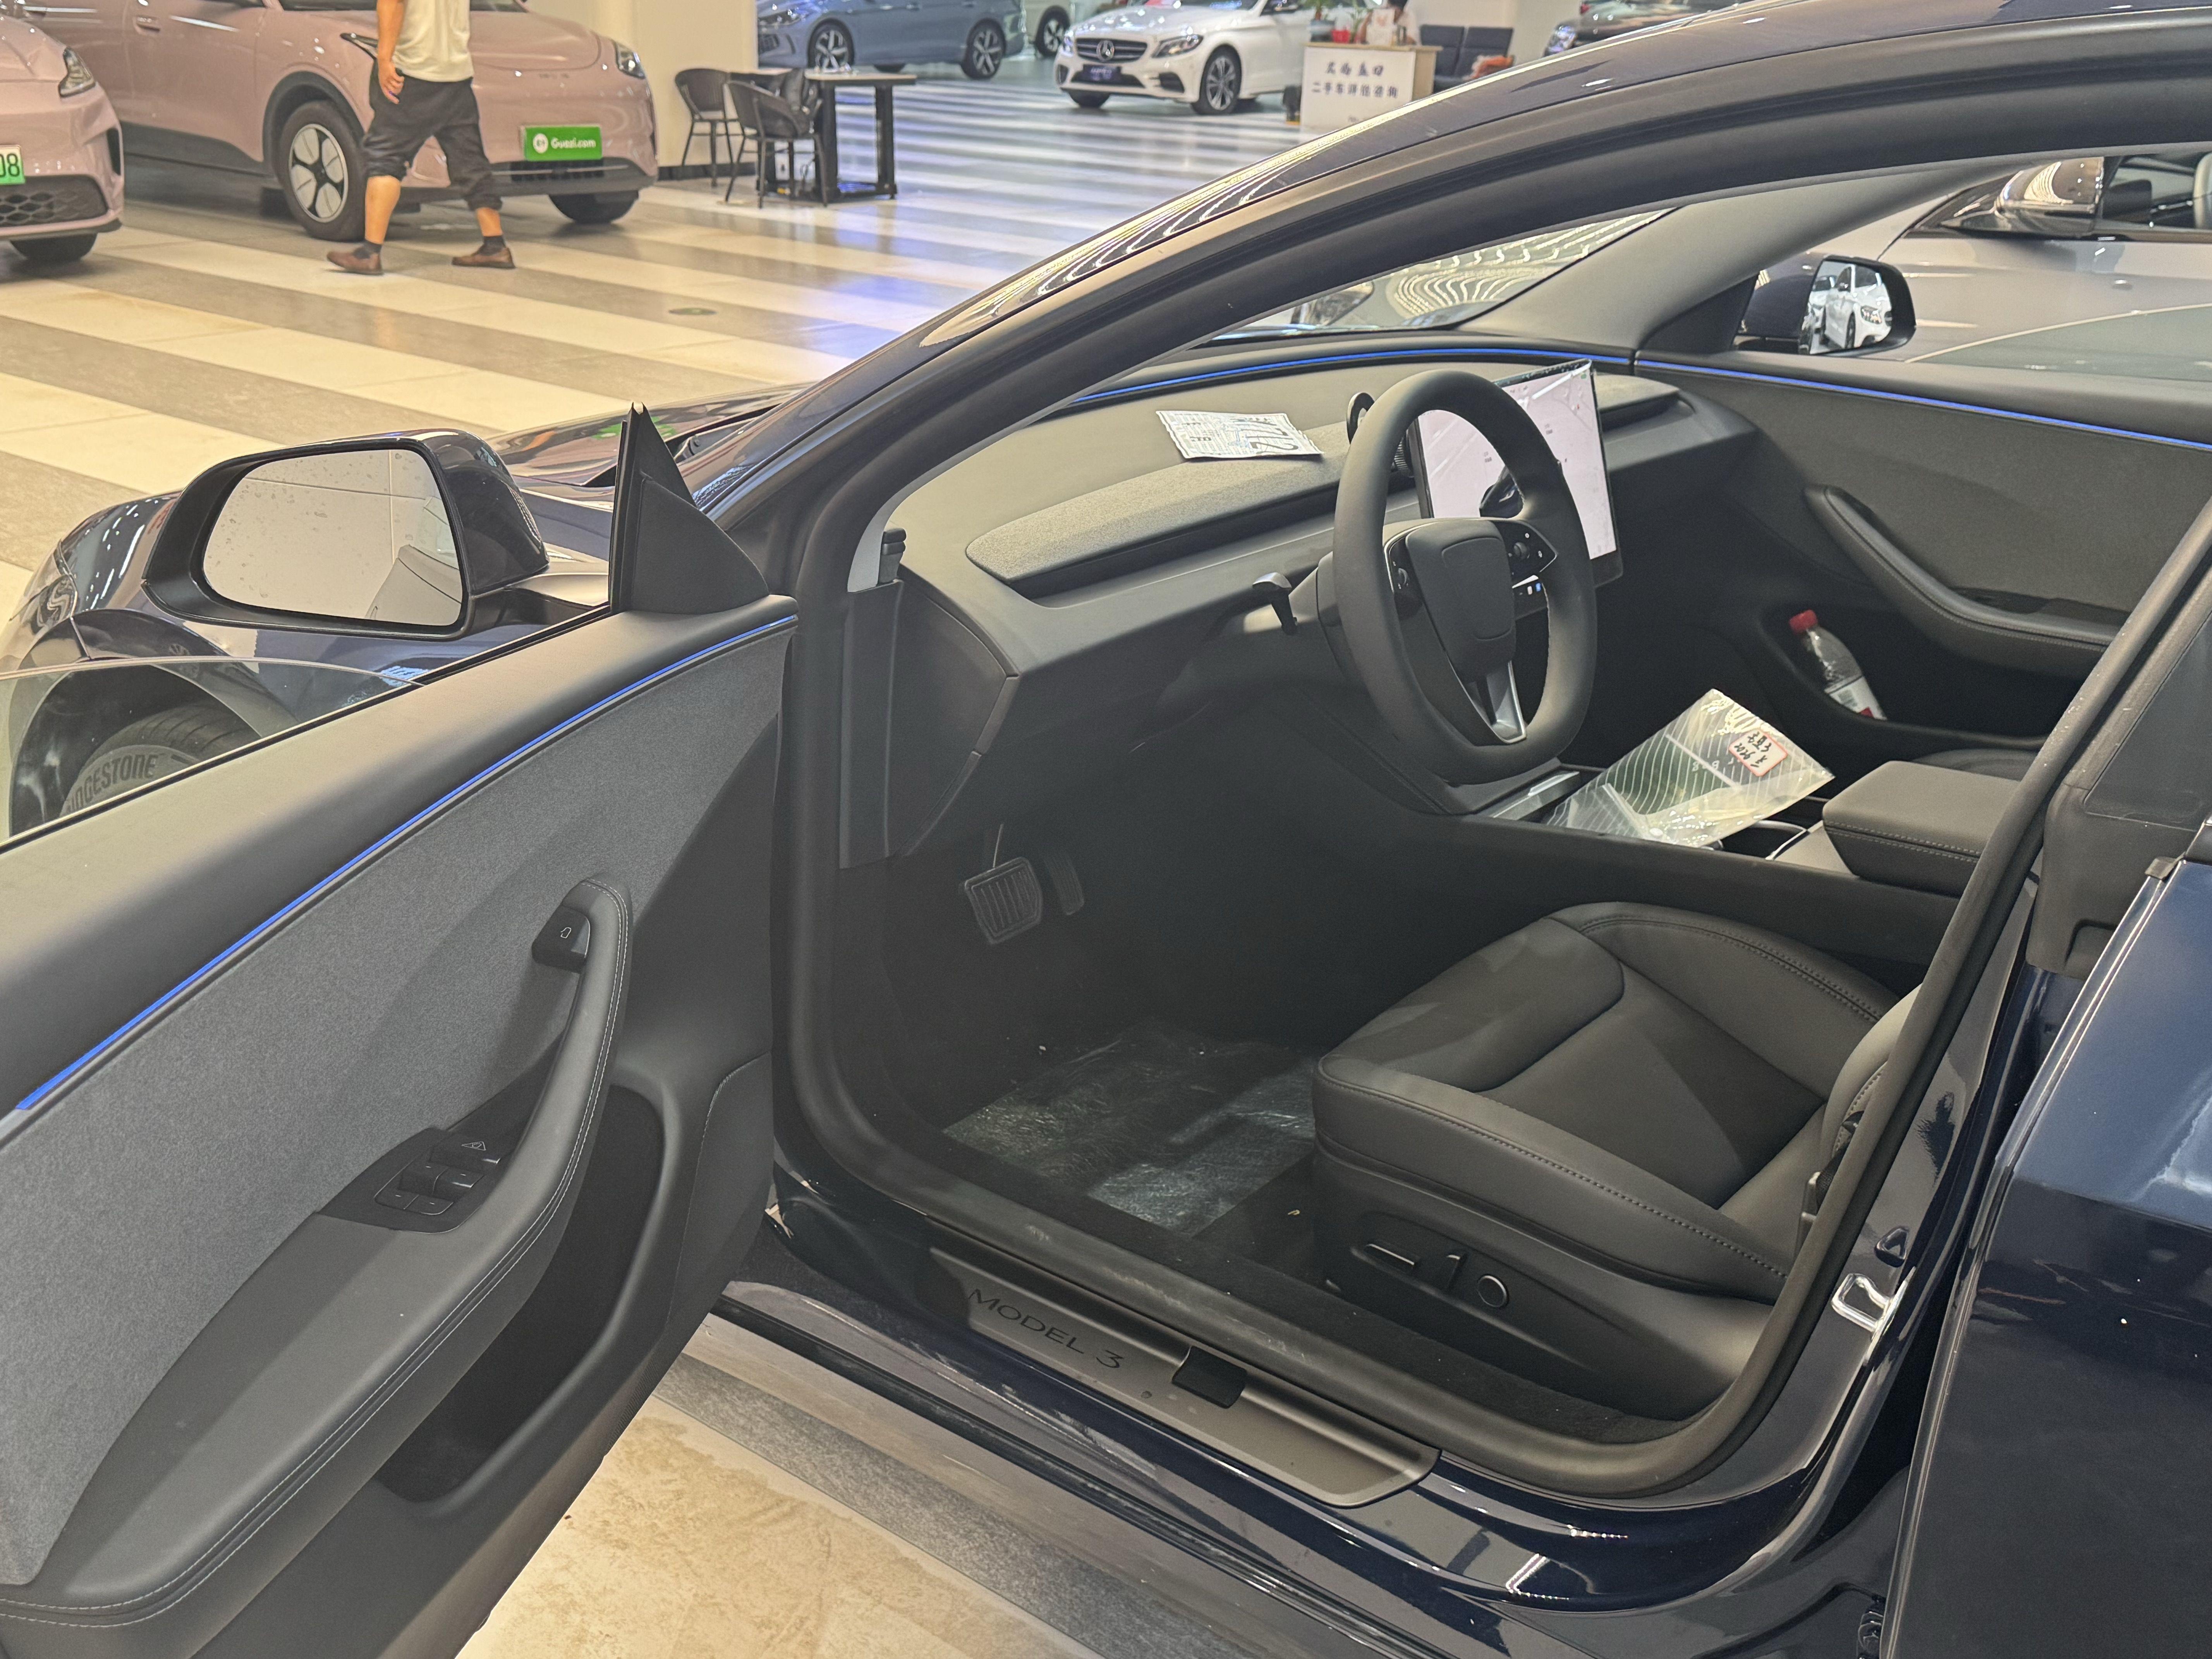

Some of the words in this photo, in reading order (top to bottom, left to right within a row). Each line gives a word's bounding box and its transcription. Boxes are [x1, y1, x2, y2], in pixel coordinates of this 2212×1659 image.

[67, 754, 158, 812] IDGESTONE
[968, 1288, 1085, 1354] MODEL
[1096, 1349, 1124, 1369] 3
